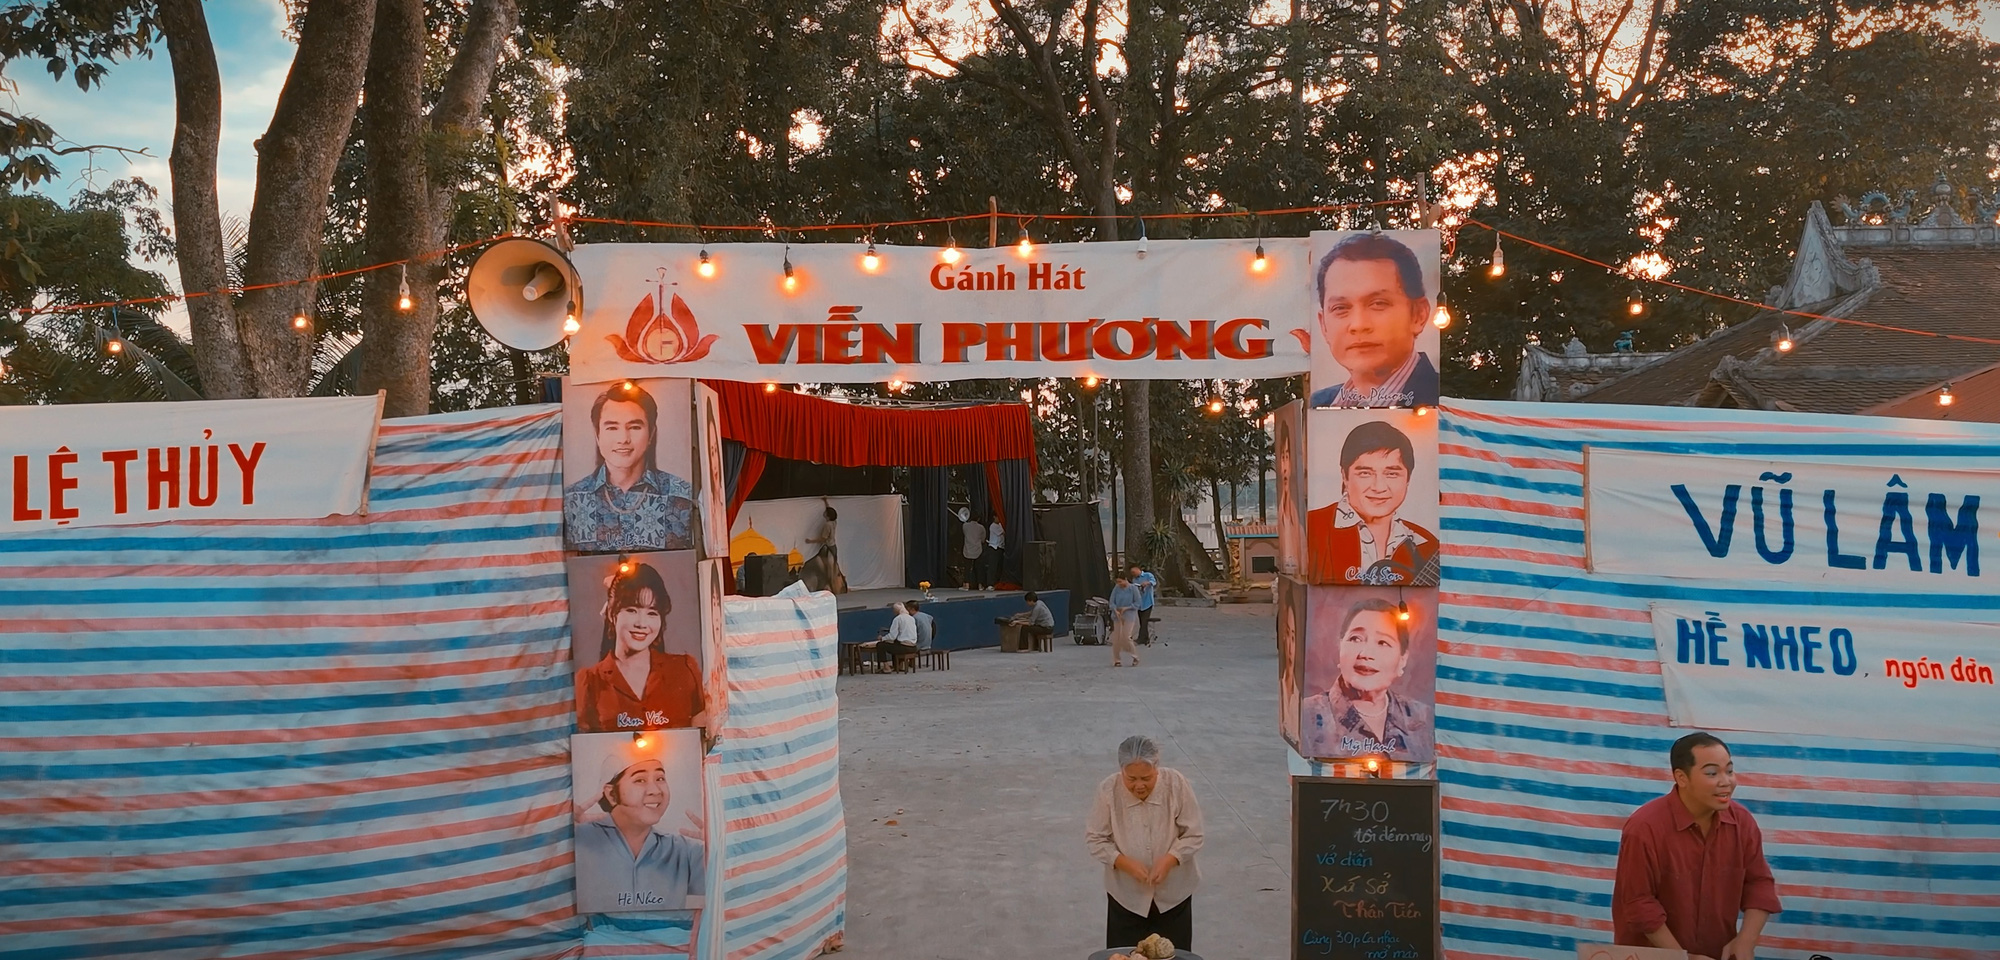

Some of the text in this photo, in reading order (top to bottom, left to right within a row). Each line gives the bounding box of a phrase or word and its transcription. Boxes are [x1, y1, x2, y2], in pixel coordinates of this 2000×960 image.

[929, 262, 1087, 291] Gánh Hát
[743, 305, 1275, 365] VIỄN PHƯƠNG
[12, 429, 267, 525] LỆ THỦY
[1670, 471, 1981, 577] VŨ LÂM
[1676, 611, 1730, 666] HỀ
[1884, 656, 1946, 689] ngón
[617, 710, 670, 728] Kim Yến
[1341, 735, 1362, 757] Mỹ
[1353, 824, 1433, 853] tối đêm nay
[617, 890, 665, 907] Hề Nheo
